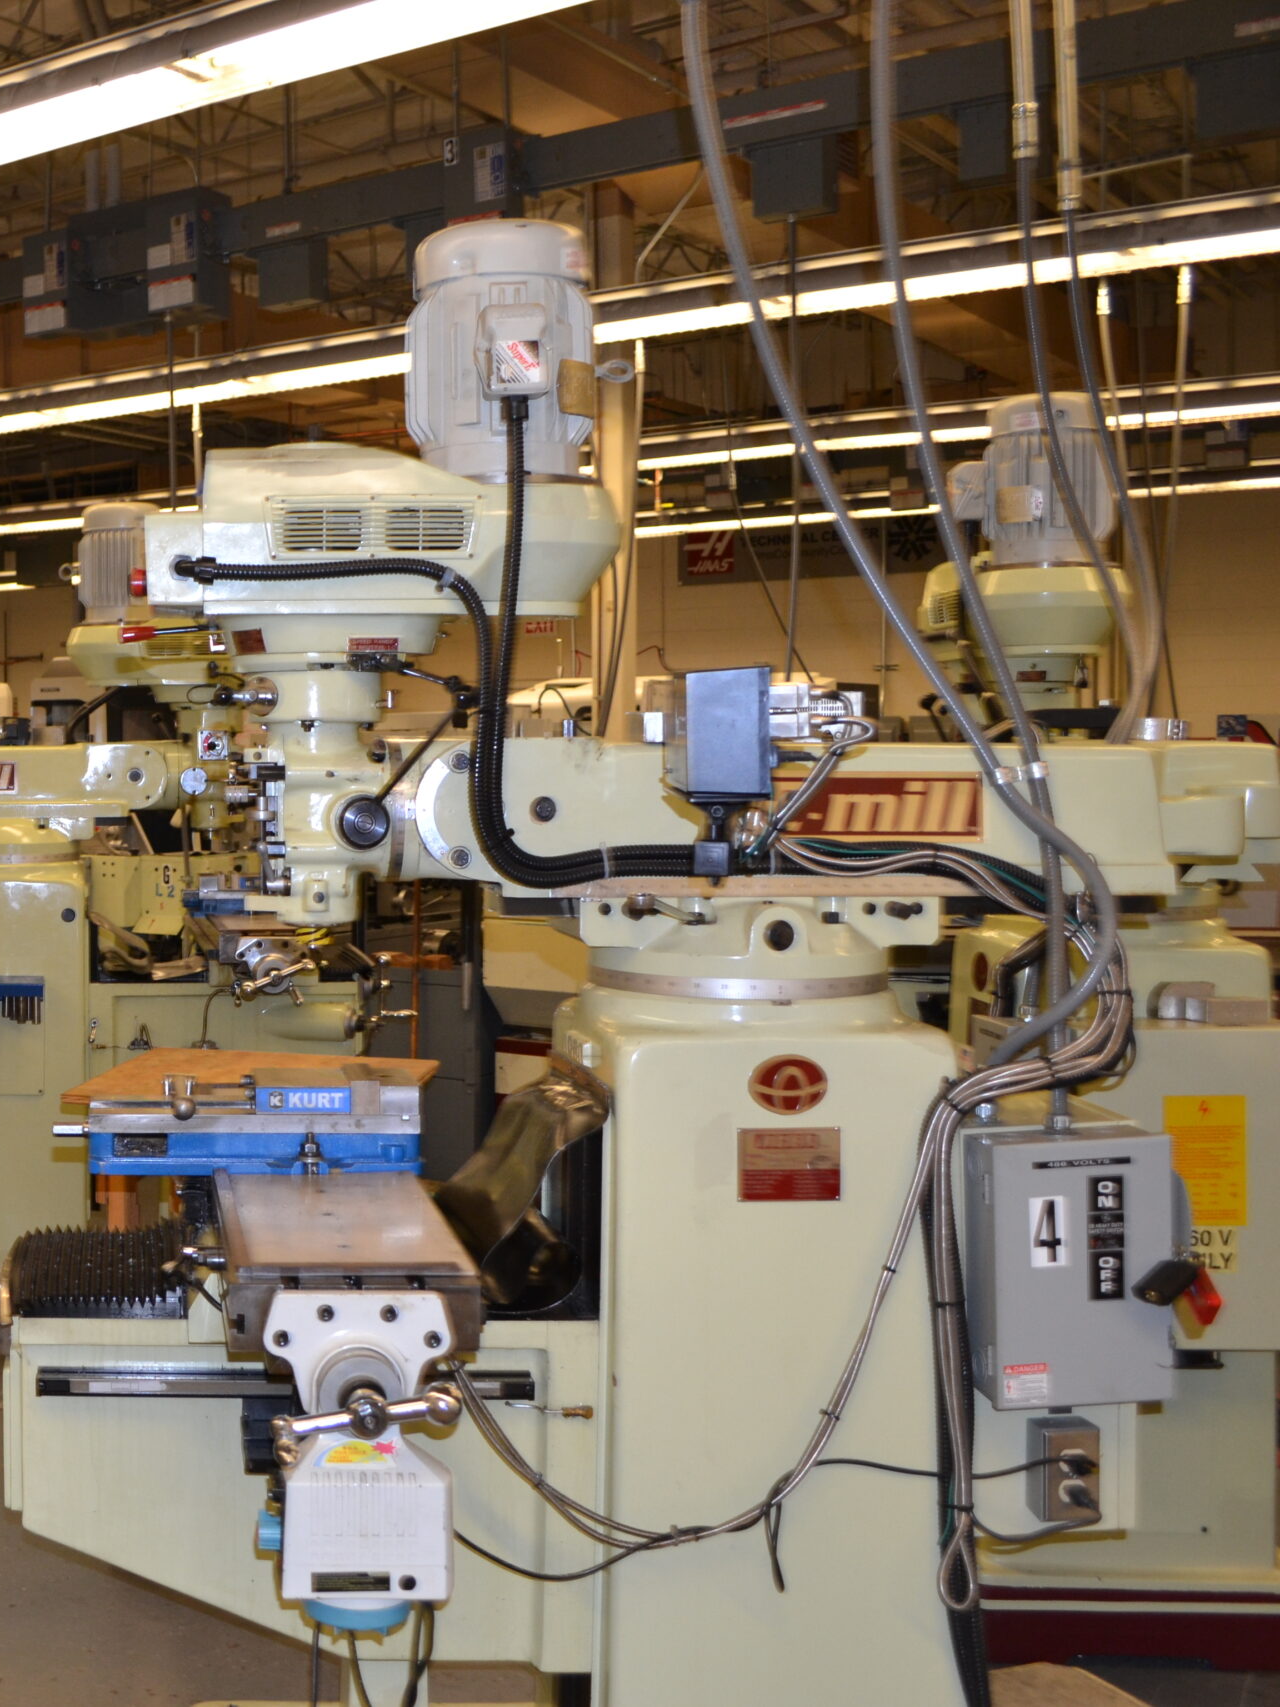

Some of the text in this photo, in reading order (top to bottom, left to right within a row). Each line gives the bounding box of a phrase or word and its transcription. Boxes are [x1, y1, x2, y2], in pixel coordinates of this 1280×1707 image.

[445, 139, 455, 164] 3
[687, 557, 735, 574] HAAS
[288, 1092, 344, 1108] KURT
[1072, 1159, 1111, 1167] VOLTS
[1098, 1181, 1120, 1208] ON
[1033, 1199, 1062, 1263] 4
[1218, 1229, 1233, 1246] V
[1099, 1256, 1120, 1293] OFF
